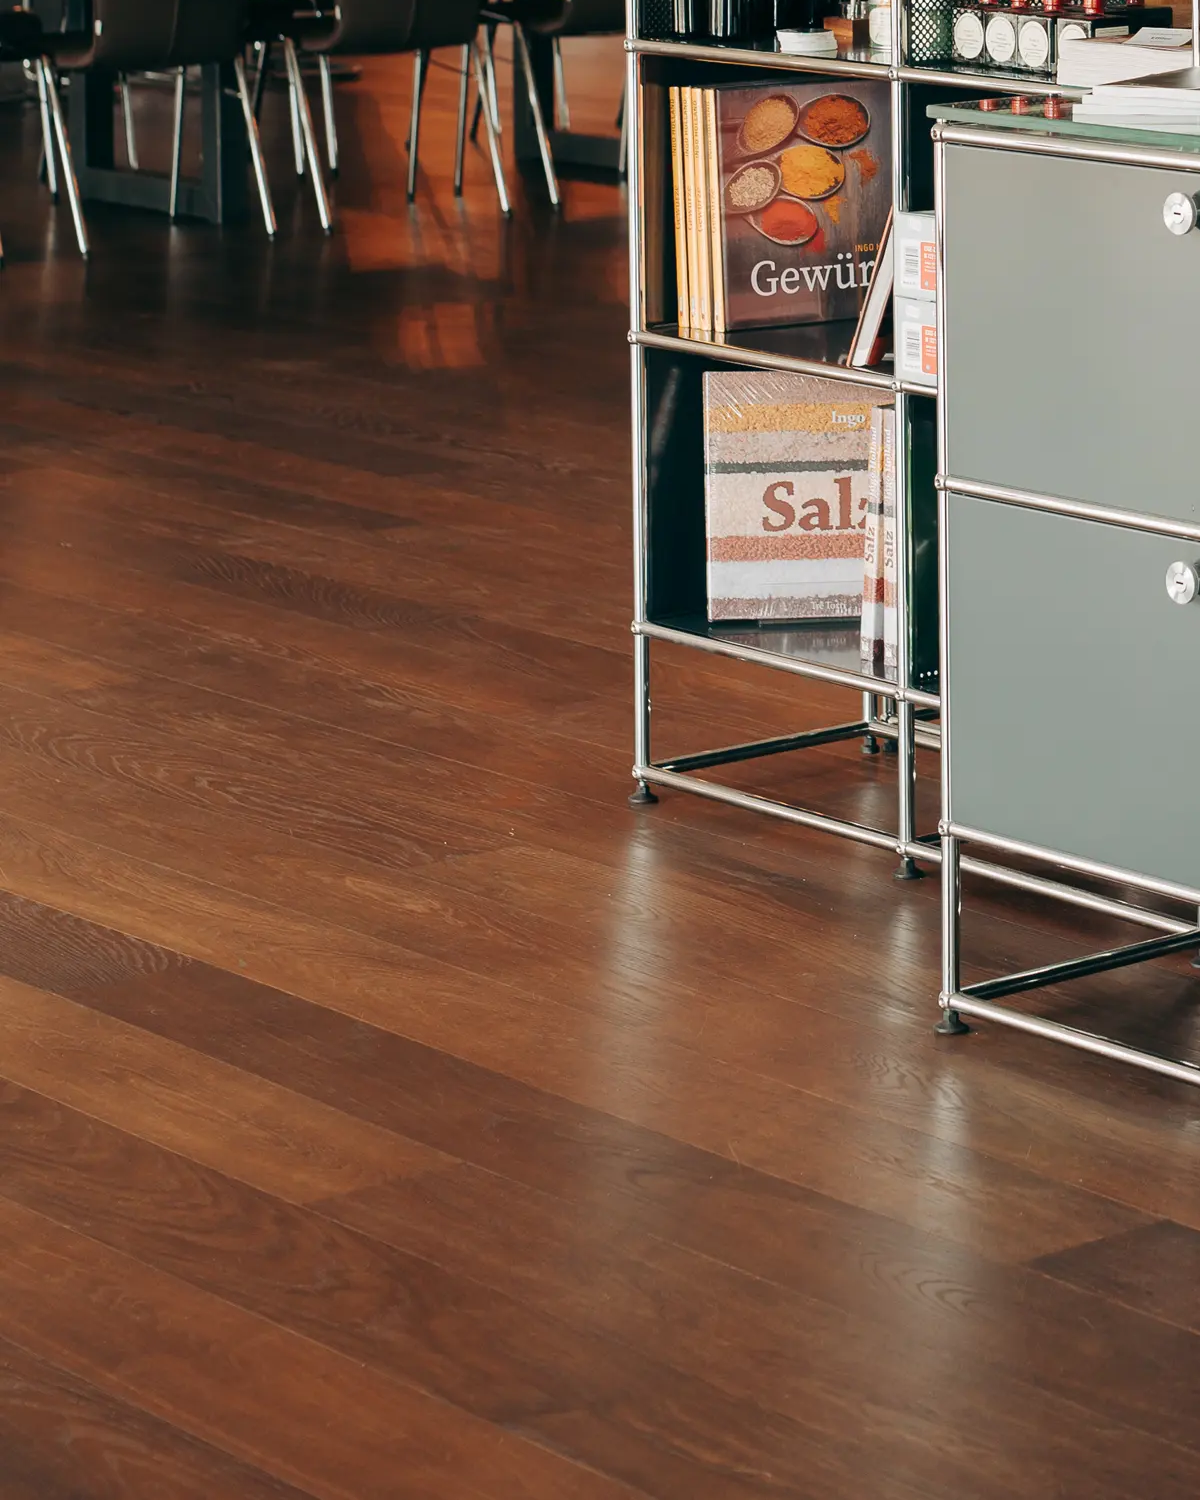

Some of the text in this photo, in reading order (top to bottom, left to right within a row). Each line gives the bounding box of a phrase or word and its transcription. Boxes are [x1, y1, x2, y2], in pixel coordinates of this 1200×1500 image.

[854, 243, 873, 252] INGO
[751, 252, 875, 297] Gewür
[832, 411, 865, 427] Ingo
[865, 526, 875, 564] Salz
[885, 530, 893, 568] Salz
